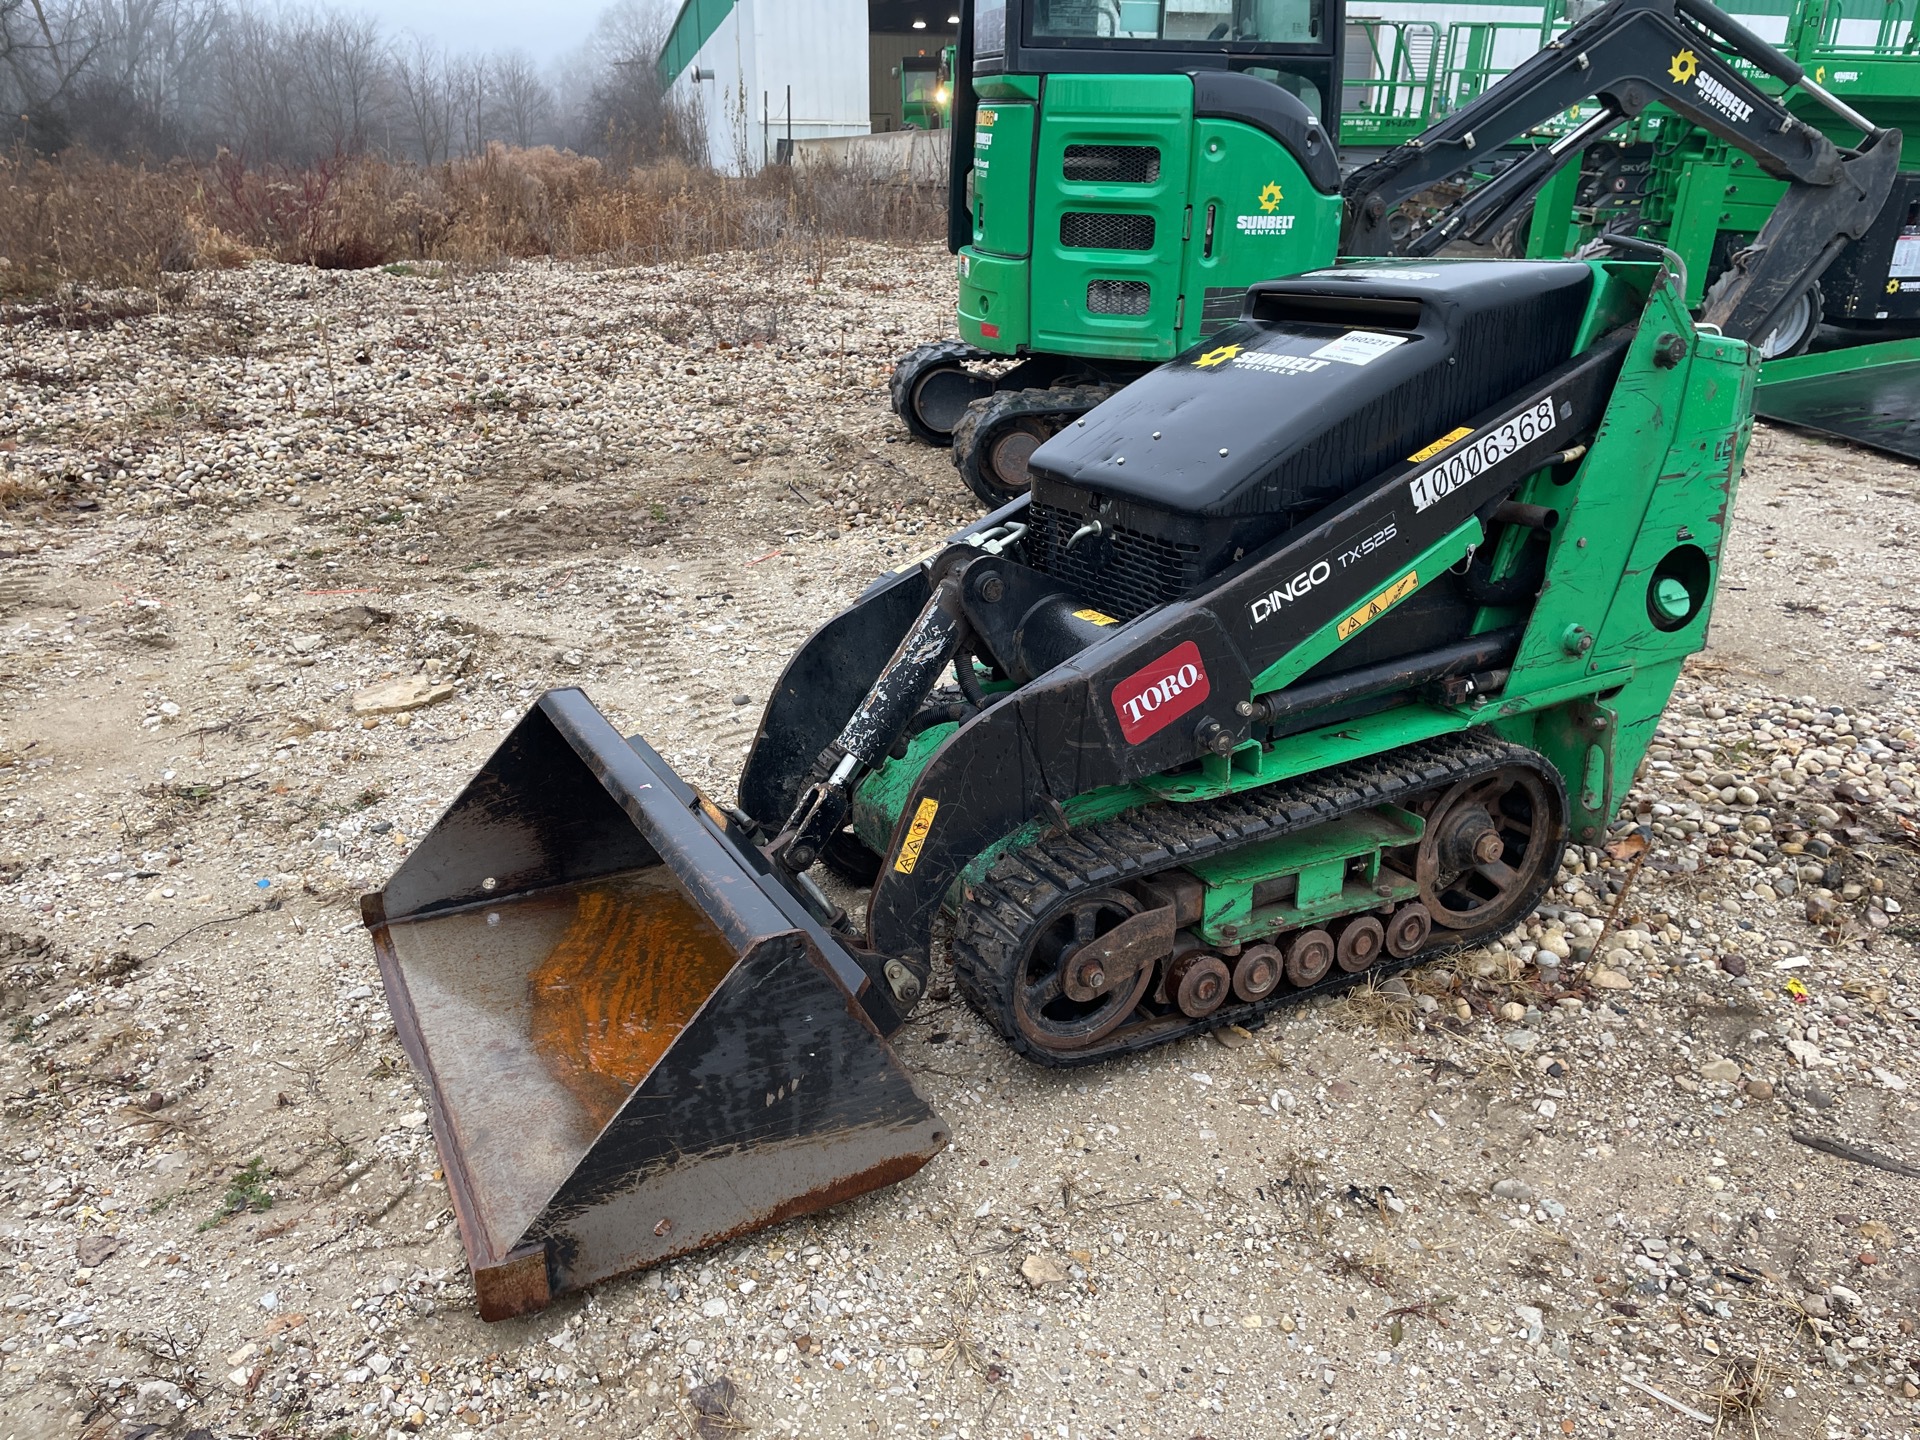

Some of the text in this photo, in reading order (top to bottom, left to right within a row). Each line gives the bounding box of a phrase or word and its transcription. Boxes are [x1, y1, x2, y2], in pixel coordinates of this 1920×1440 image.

[1694, 70, 1754, 121] SUNBELT
[1698, 89, 1738, 122] RENTALS
[1236, 215, 1296, 229] SUNBELT
[1233, 351, 1331, 373] SUNBELT
[1415, 402, 1553, 501] 10006368
[1251, 560, 1331, 624] DINGO
[1122, 663, 1199, 724] TORO
